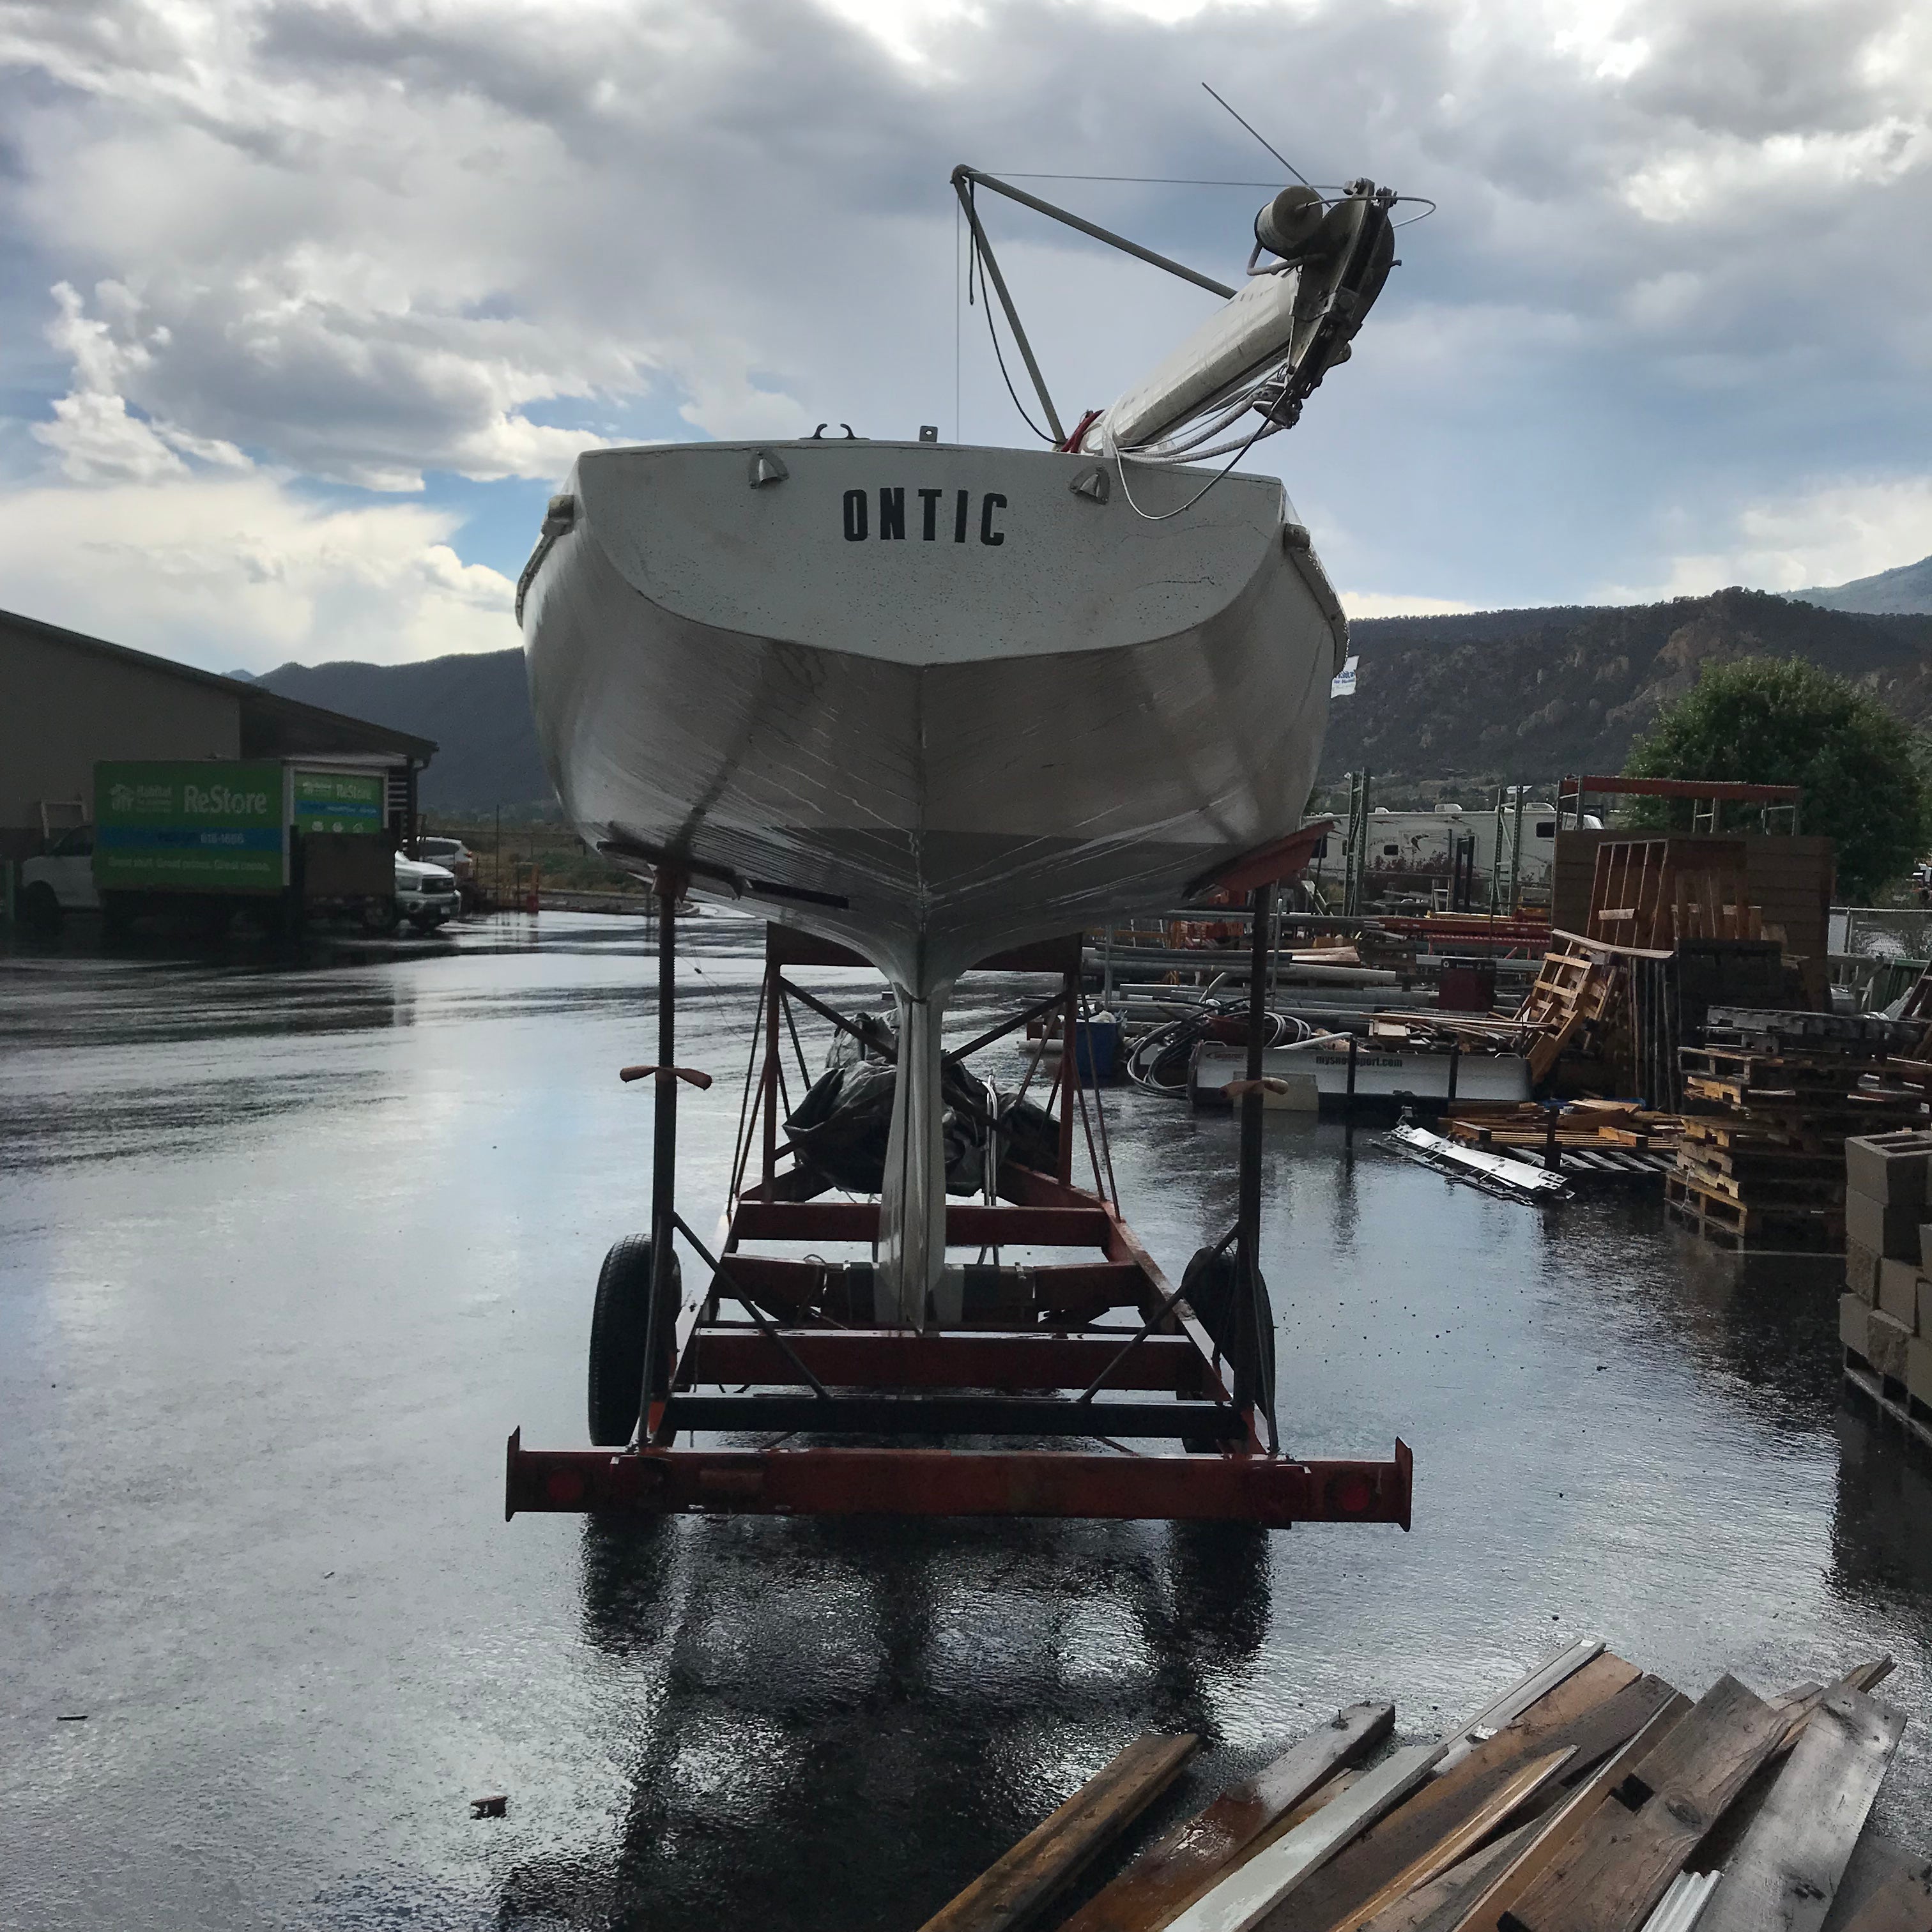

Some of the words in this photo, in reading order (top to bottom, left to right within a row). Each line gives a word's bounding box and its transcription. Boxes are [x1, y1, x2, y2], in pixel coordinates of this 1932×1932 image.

[843, 487, 1008, 546] ONTIC
[183, 784, 268, 815] ReStore
[1315, 1055, 1403, 1068] mysnosport.com
